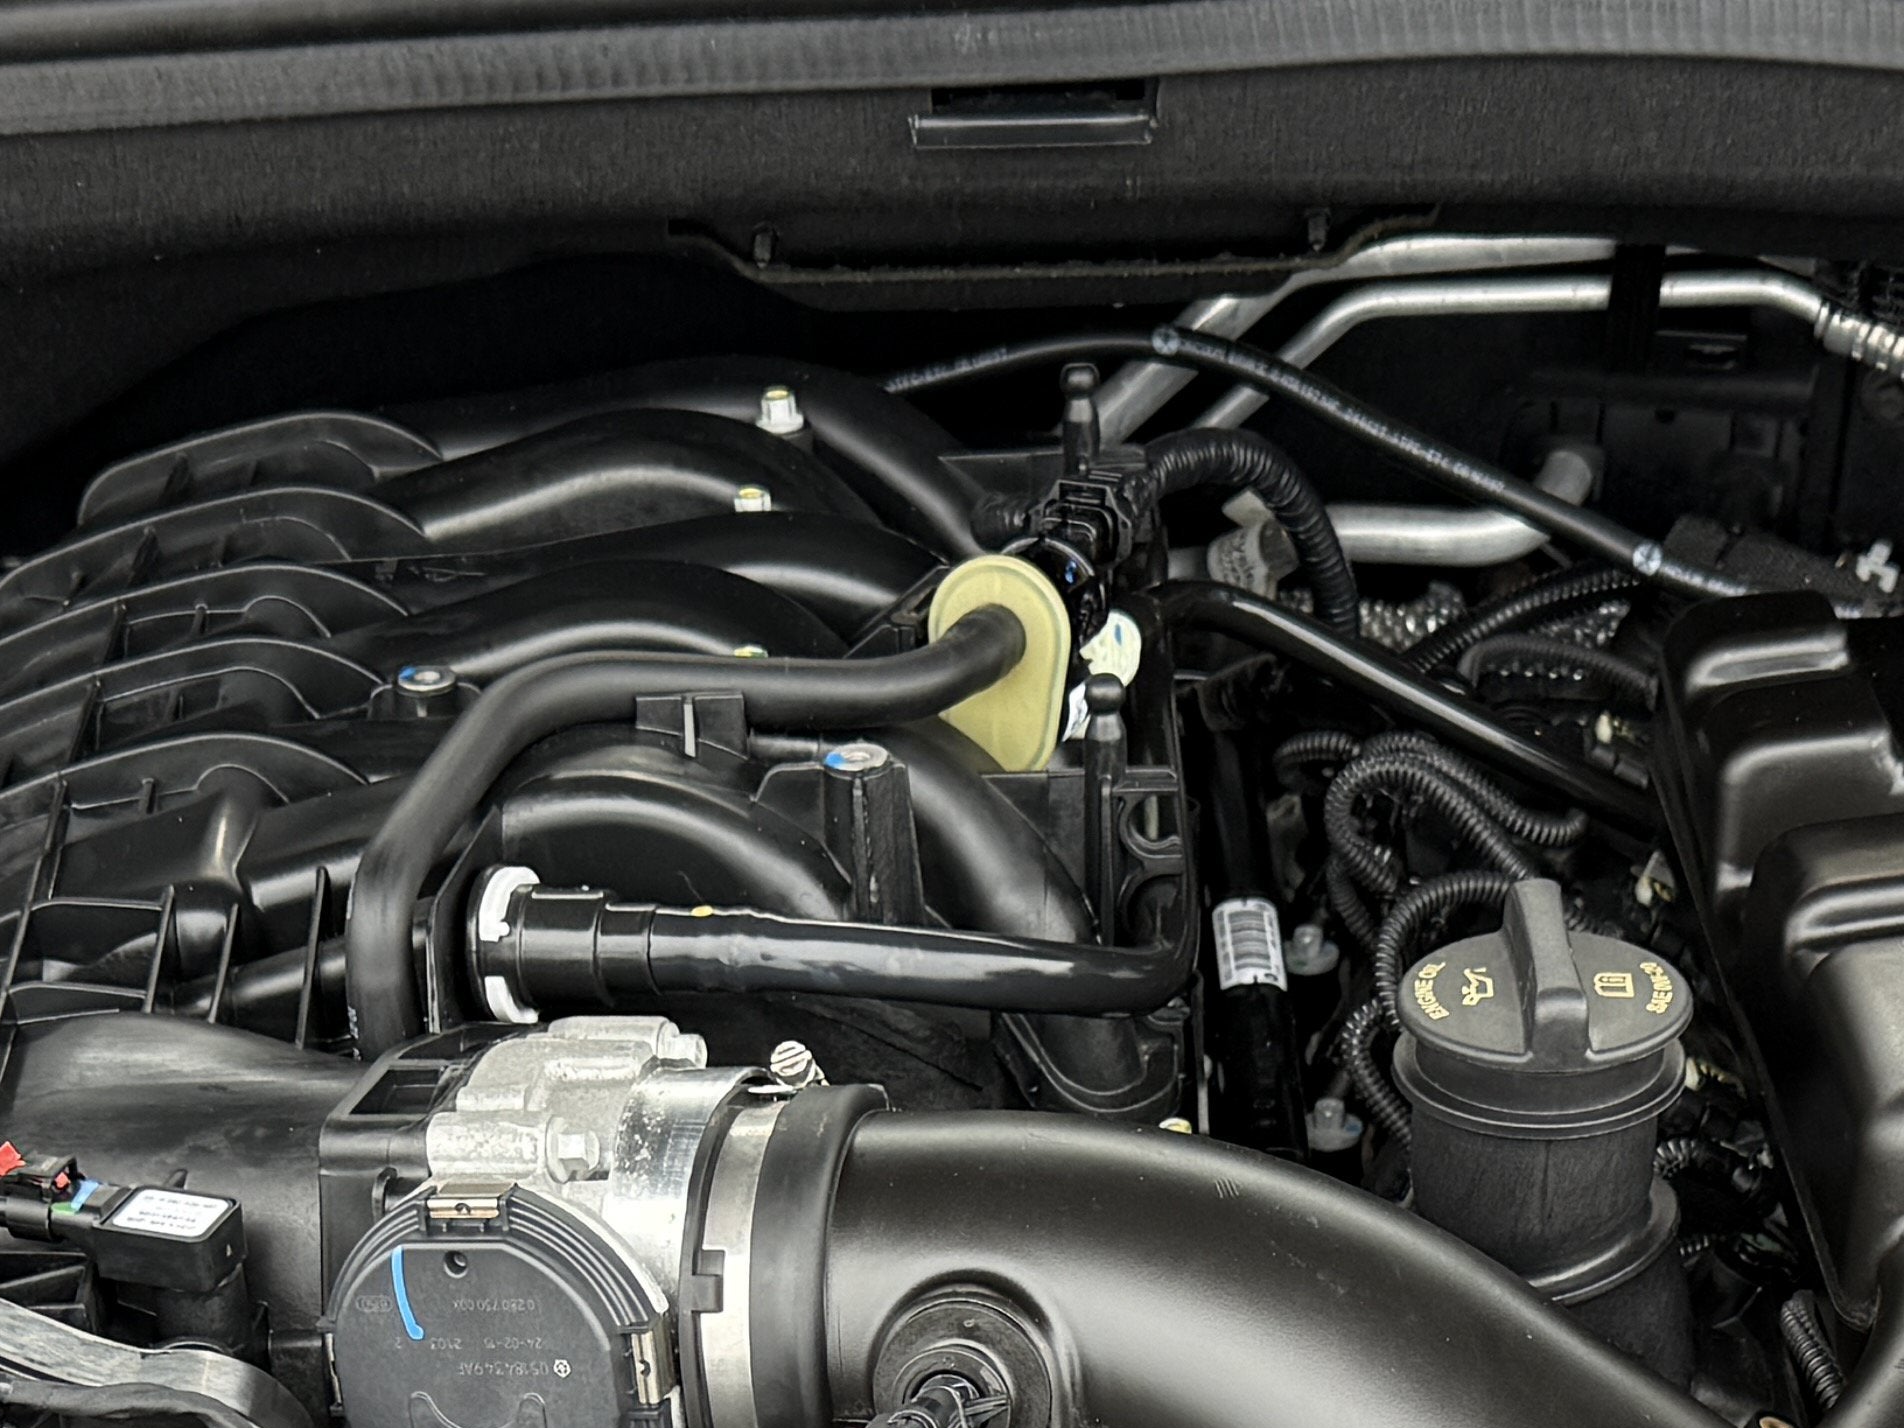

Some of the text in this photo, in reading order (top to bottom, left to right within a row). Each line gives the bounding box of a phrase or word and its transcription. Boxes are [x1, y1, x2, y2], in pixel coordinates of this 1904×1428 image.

[1413, 961, 1450, 1021] ENGINE OIL
[1645, 991, 1674, 1015] SAE
